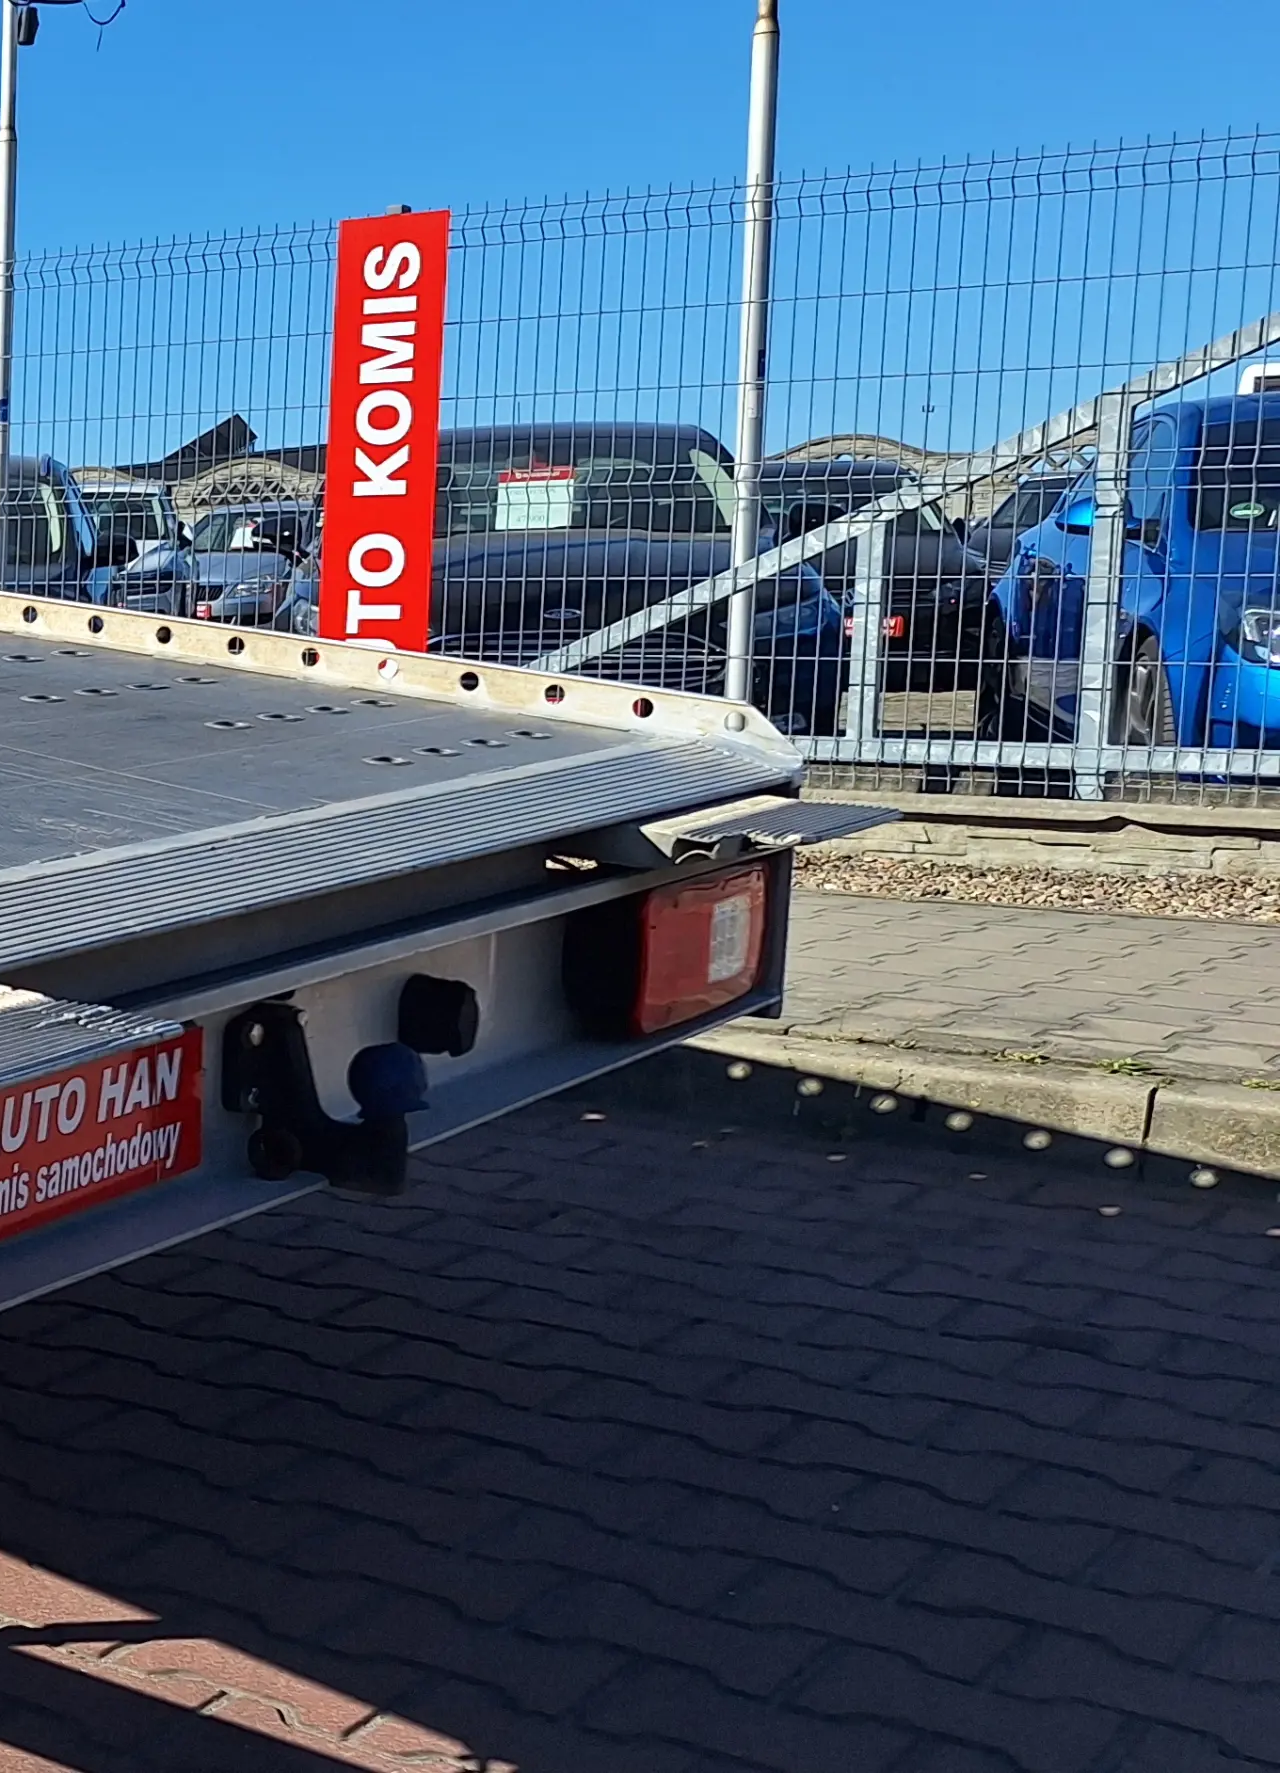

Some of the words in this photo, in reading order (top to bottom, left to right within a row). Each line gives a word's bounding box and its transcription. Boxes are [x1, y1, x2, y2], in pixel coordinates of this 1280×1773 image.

[352, 241, 421, 497] KOMIS
[344, 533, 406, 650] TO
[97, 1047, 183, 1123] HAN
[35, 1121, 182, 1203] samochodowy
